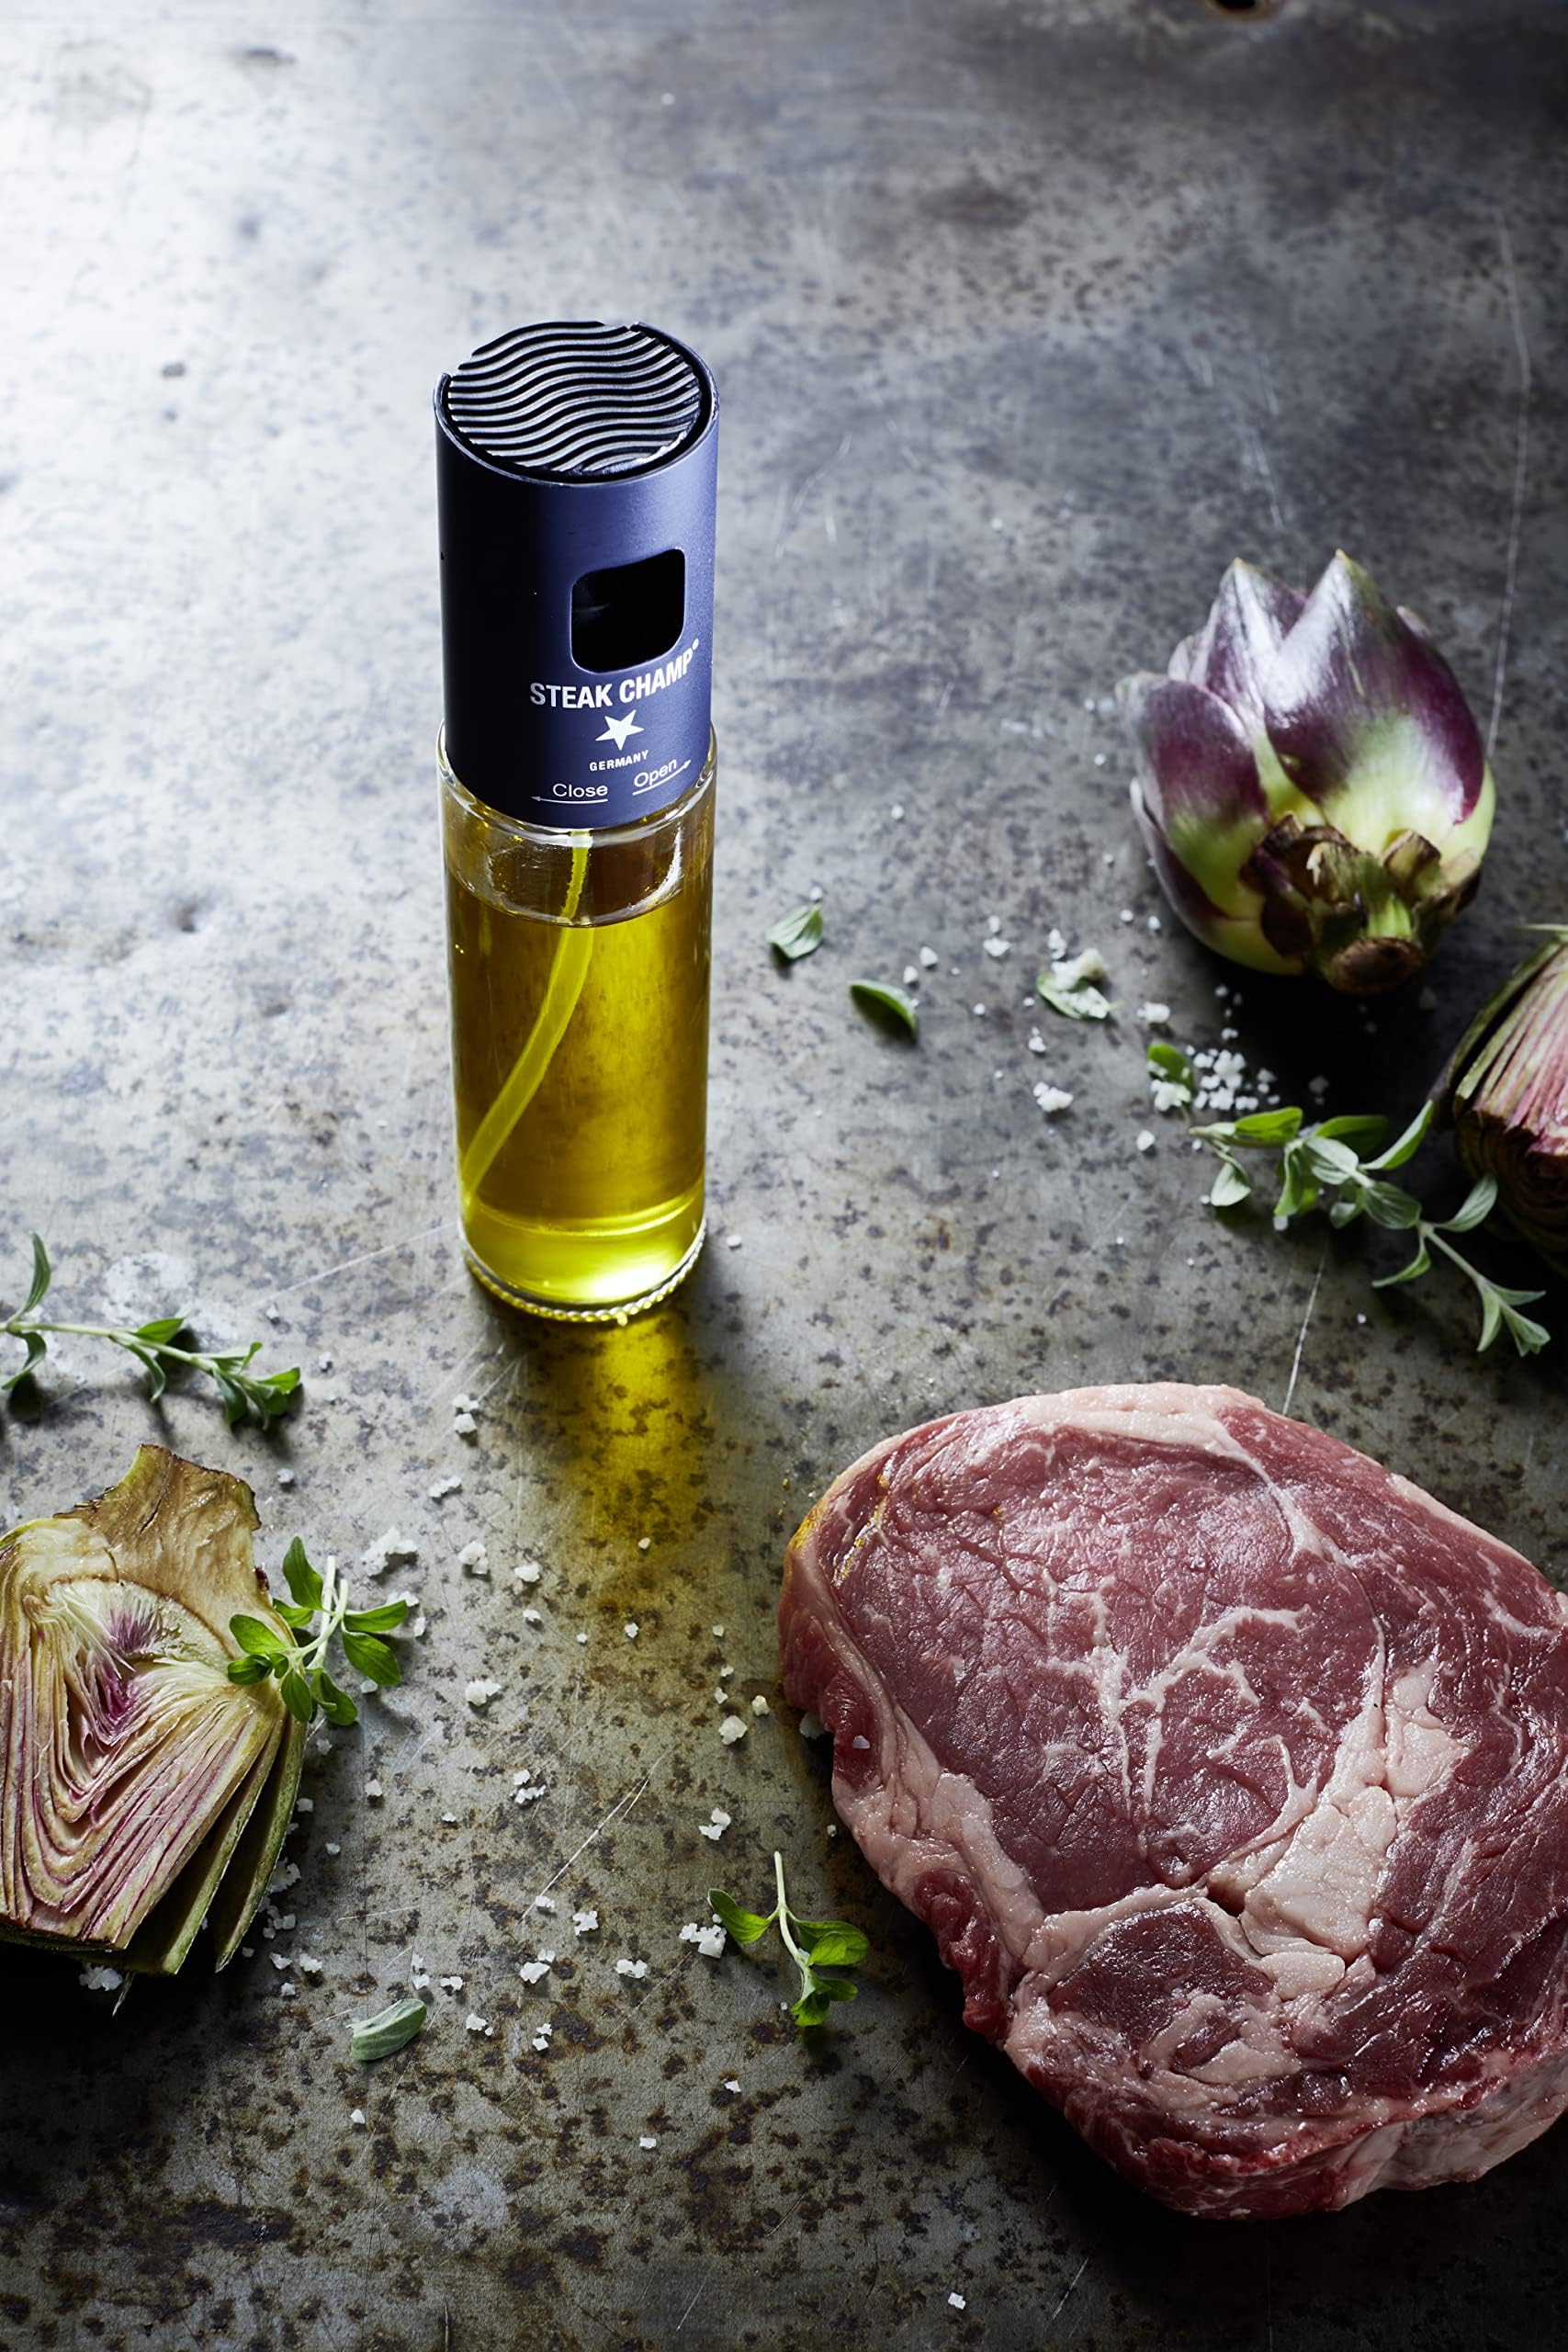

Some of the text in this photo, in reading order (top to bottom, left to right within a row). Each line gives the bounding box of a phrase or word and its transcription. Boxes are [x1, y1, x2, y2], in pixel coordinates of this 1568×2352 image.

[530, 682, 613, 708] STEAK
[589, 750, 649, 772] GERMANY
[552, 759, 678, 798] Close Open
